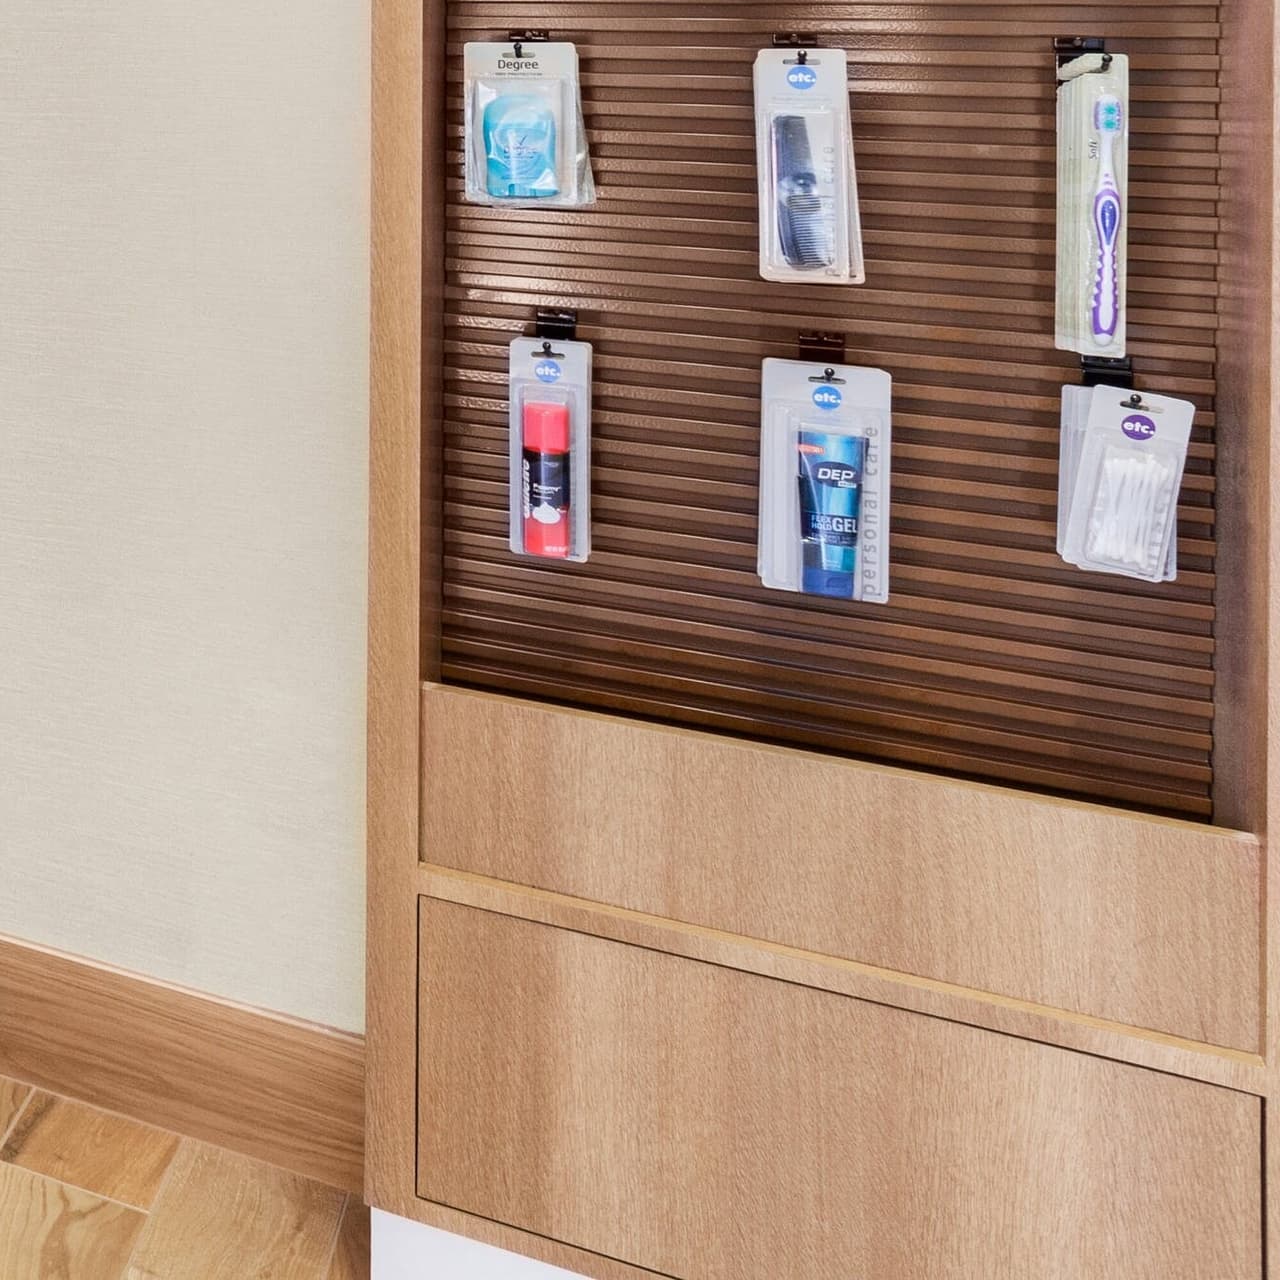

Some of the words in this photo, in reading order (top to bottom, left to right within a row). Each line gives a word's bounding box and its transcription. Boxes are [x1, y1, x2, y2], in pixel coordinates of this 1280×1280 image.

[497, 59, 539, 71] Degree
[788, 73, 817, 83] etc.
[534, 366, 561, 377] etc.
[813, 392, 841, 404] etc.
[1123, 420, 1155, 435] etc.
[863, 426, 879, 477] care
[817, 468, 854, 481] DEP
[832, 517, 857, 533] GEL
[864, 489, 882, 597] personal
